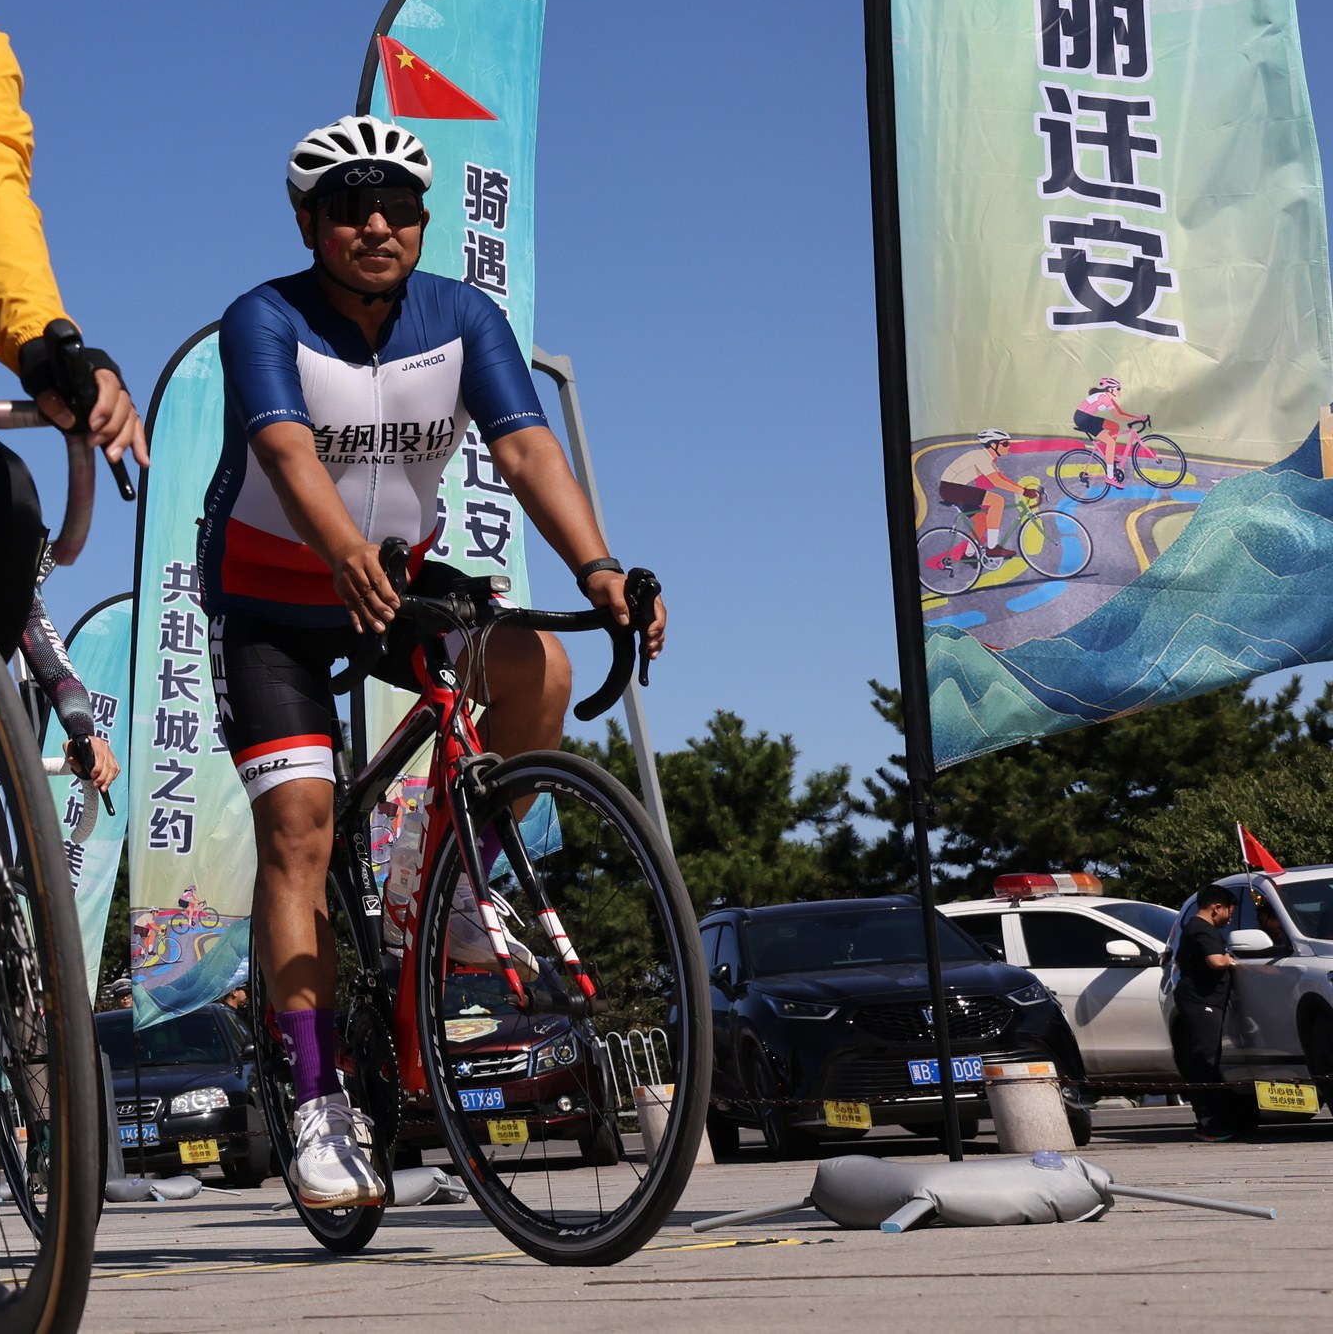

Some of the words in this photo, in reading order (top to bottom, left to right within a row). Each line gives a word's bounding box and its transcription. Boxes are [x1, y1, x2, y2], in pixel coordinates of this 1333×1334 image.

[401, 353, 446, 372] JAKROO
[463, 161, 514, 569] 骑遇迁安
[312, 417, 456, 454] 首钢股份
[317, 453, 395, 465] OUGANG
[403, 449, 449, 464] STEEL
[148, 560, 205, 856] 共赴长城之约
[911, 1060, 982, 1081] 冀B·D08
